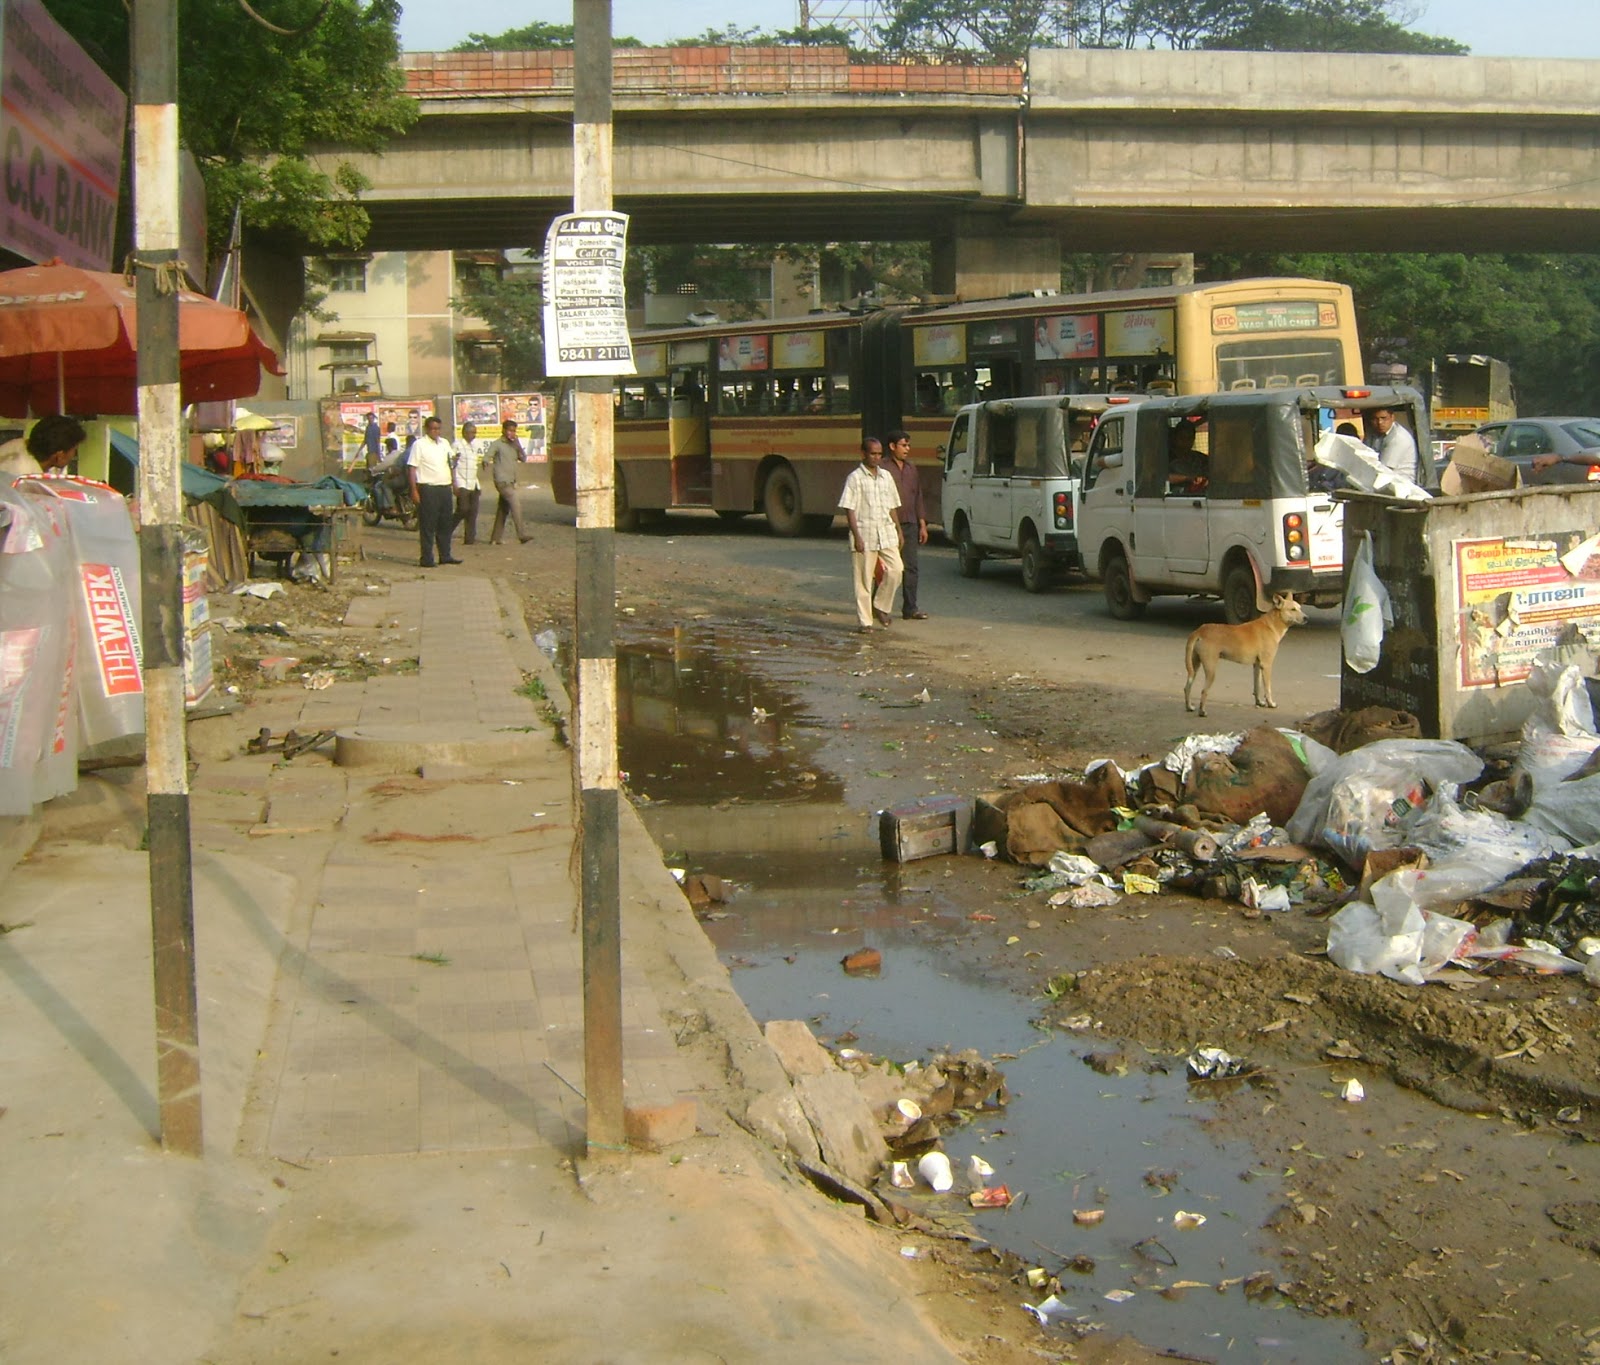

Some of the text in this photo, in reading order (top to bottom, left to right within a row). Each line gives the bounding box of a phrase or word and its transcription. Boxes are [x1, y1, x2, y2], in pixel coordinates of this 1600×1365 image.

[579, 249, 598, 258] Call
[1321, 312, 1336, 321] MTC
[1215, 317, 1235, 326] MTC
[560, 348, 592, 361] 9841
[87, 572, 128, 643] WEEK
